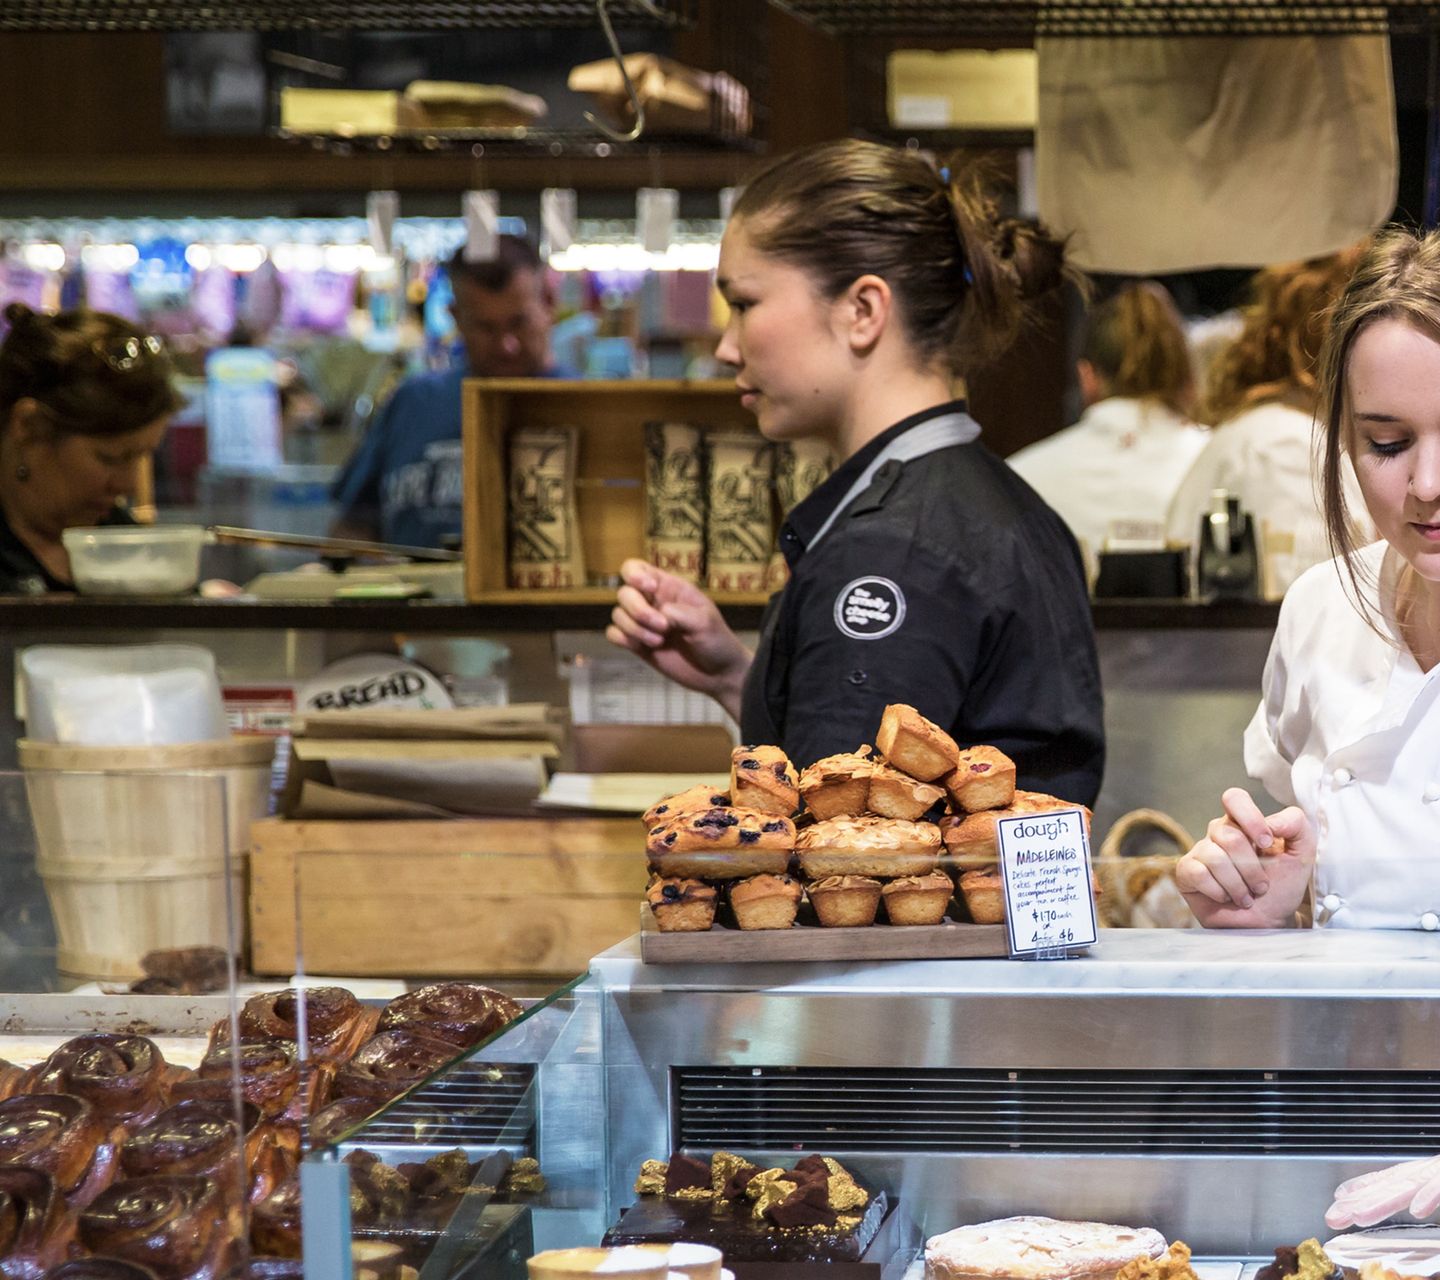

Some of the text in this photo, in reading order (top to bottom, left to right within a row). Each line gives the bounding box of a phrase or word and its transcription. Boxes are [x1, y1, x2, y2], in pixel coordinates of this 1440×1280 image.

[309, 671, 426, 711] BREAD
[1013, 818, 1069, 841] dough
[1016, 846, 1077, 866] MADELEINES
[1034, 876, 1057, 889] perfect
[1058, 893, 1080, 905] coffee
[1059, 927, 1074, 942] $6
